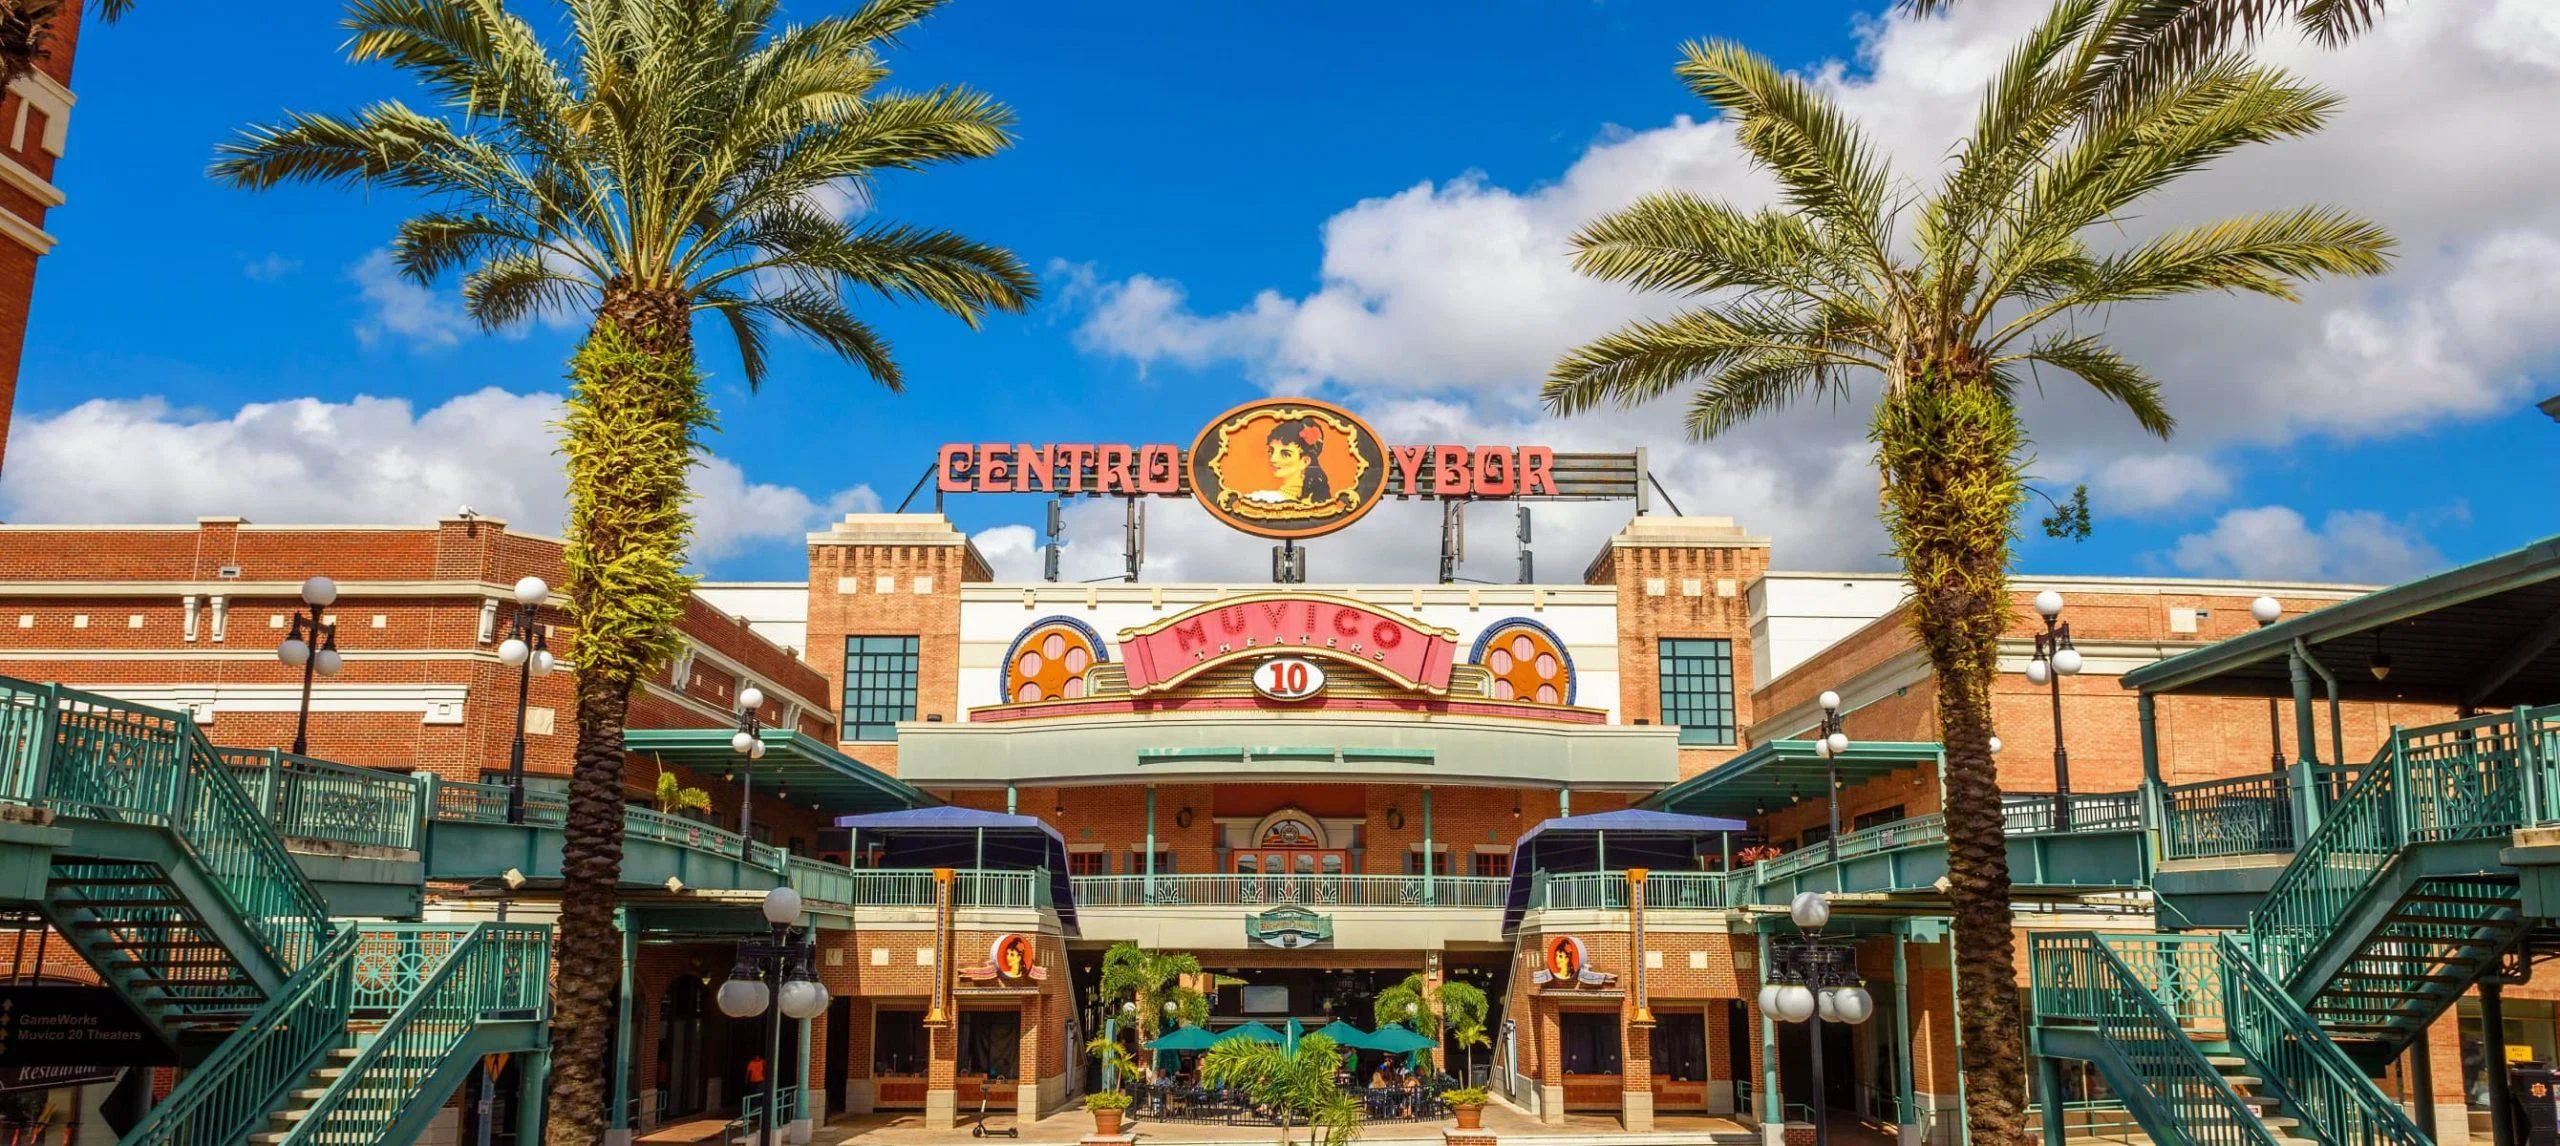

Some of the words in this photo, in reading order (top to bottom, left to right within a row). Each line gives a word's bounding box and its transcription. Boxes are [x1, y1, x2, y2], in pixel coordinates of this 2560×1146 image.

[938, 443, 1180, 493] CENTRO
[1389, 445, 1560, 496] YBOR
[1175, 603, 1402, 651] MUVICO
[1195, 635, 1385, 661] THEATERS
[1270, 662, 1308, 694] 10
[17, 1029, 65, 1040] Muvico
[68, 1029, 83, 1040] 20
[88, 1029, 142, 1040] Theaters
[19, 1014, 98, 1026] GameWorks
